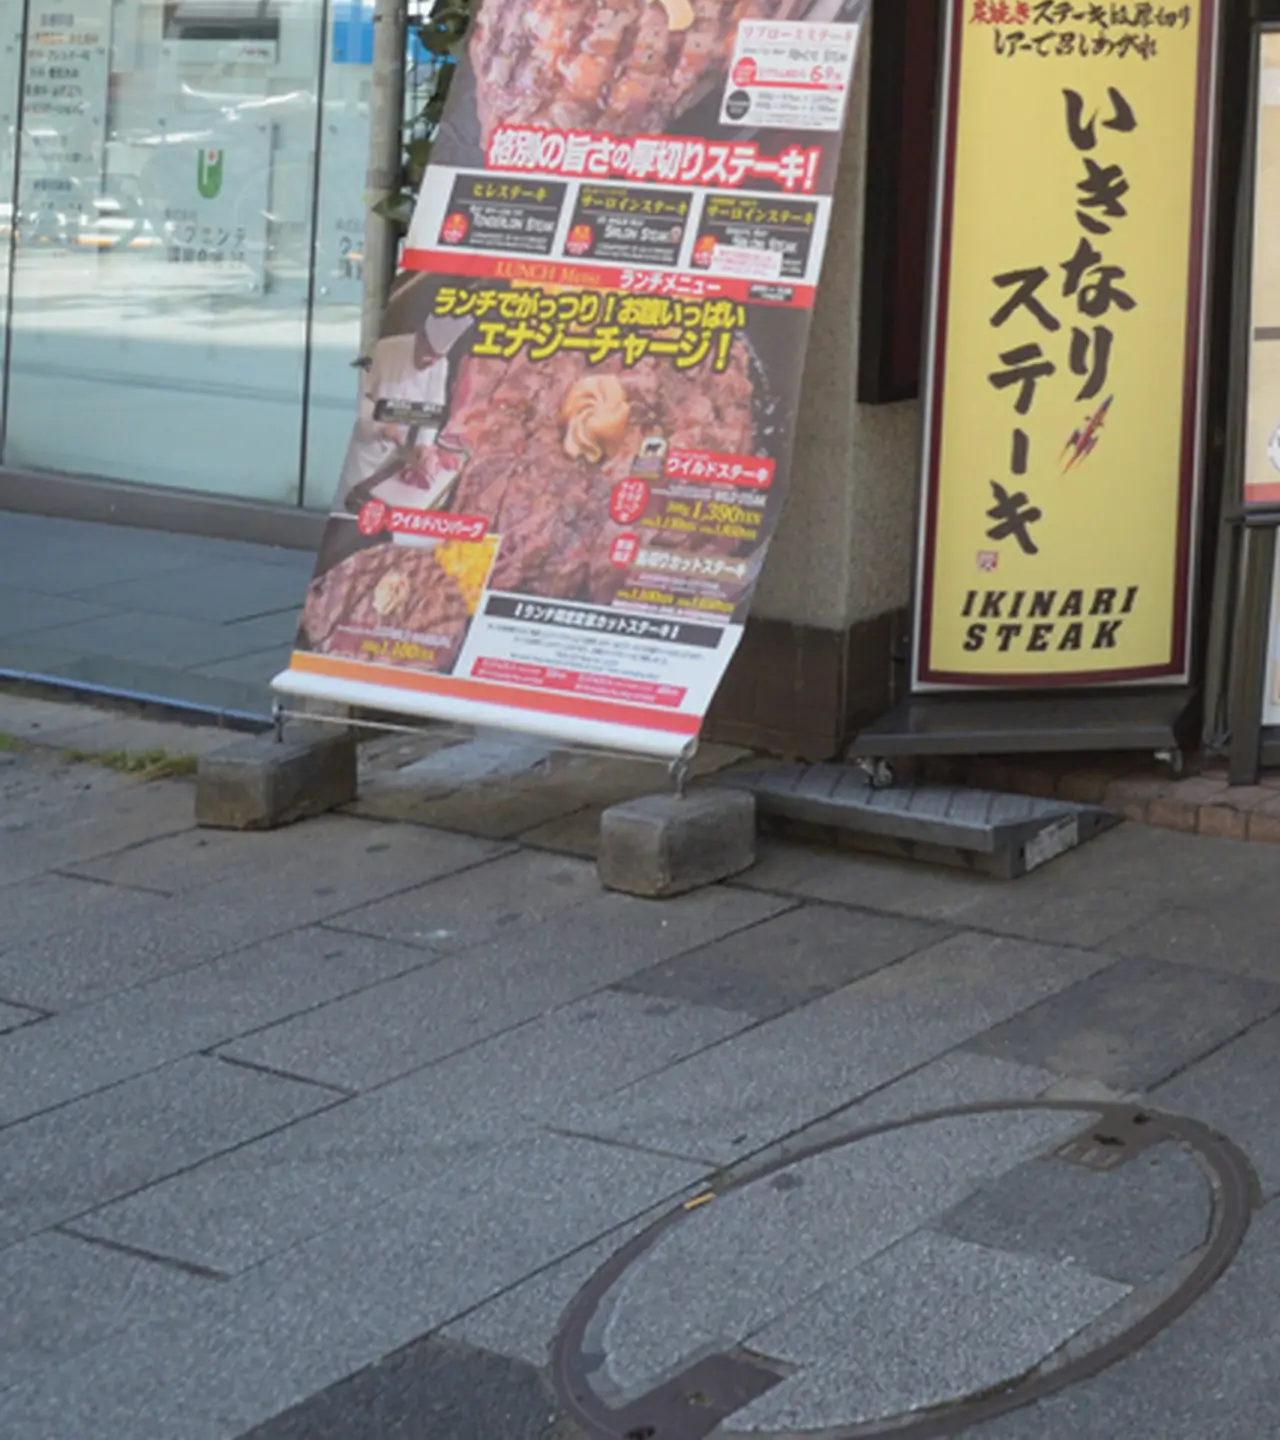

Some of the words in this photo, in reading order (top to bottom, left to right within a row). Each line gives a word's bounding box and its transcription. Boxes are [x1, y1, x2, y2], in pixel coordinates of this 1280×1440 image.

[1061, 86, 1138, 403] いきなり
[620, 269, 722, 293] ランチメニュー
[985, 264, 1062, 556] ステーキ
[961, 585, 1139, 619] IKINARI
[963, 620, 1124, 653] STEAK
